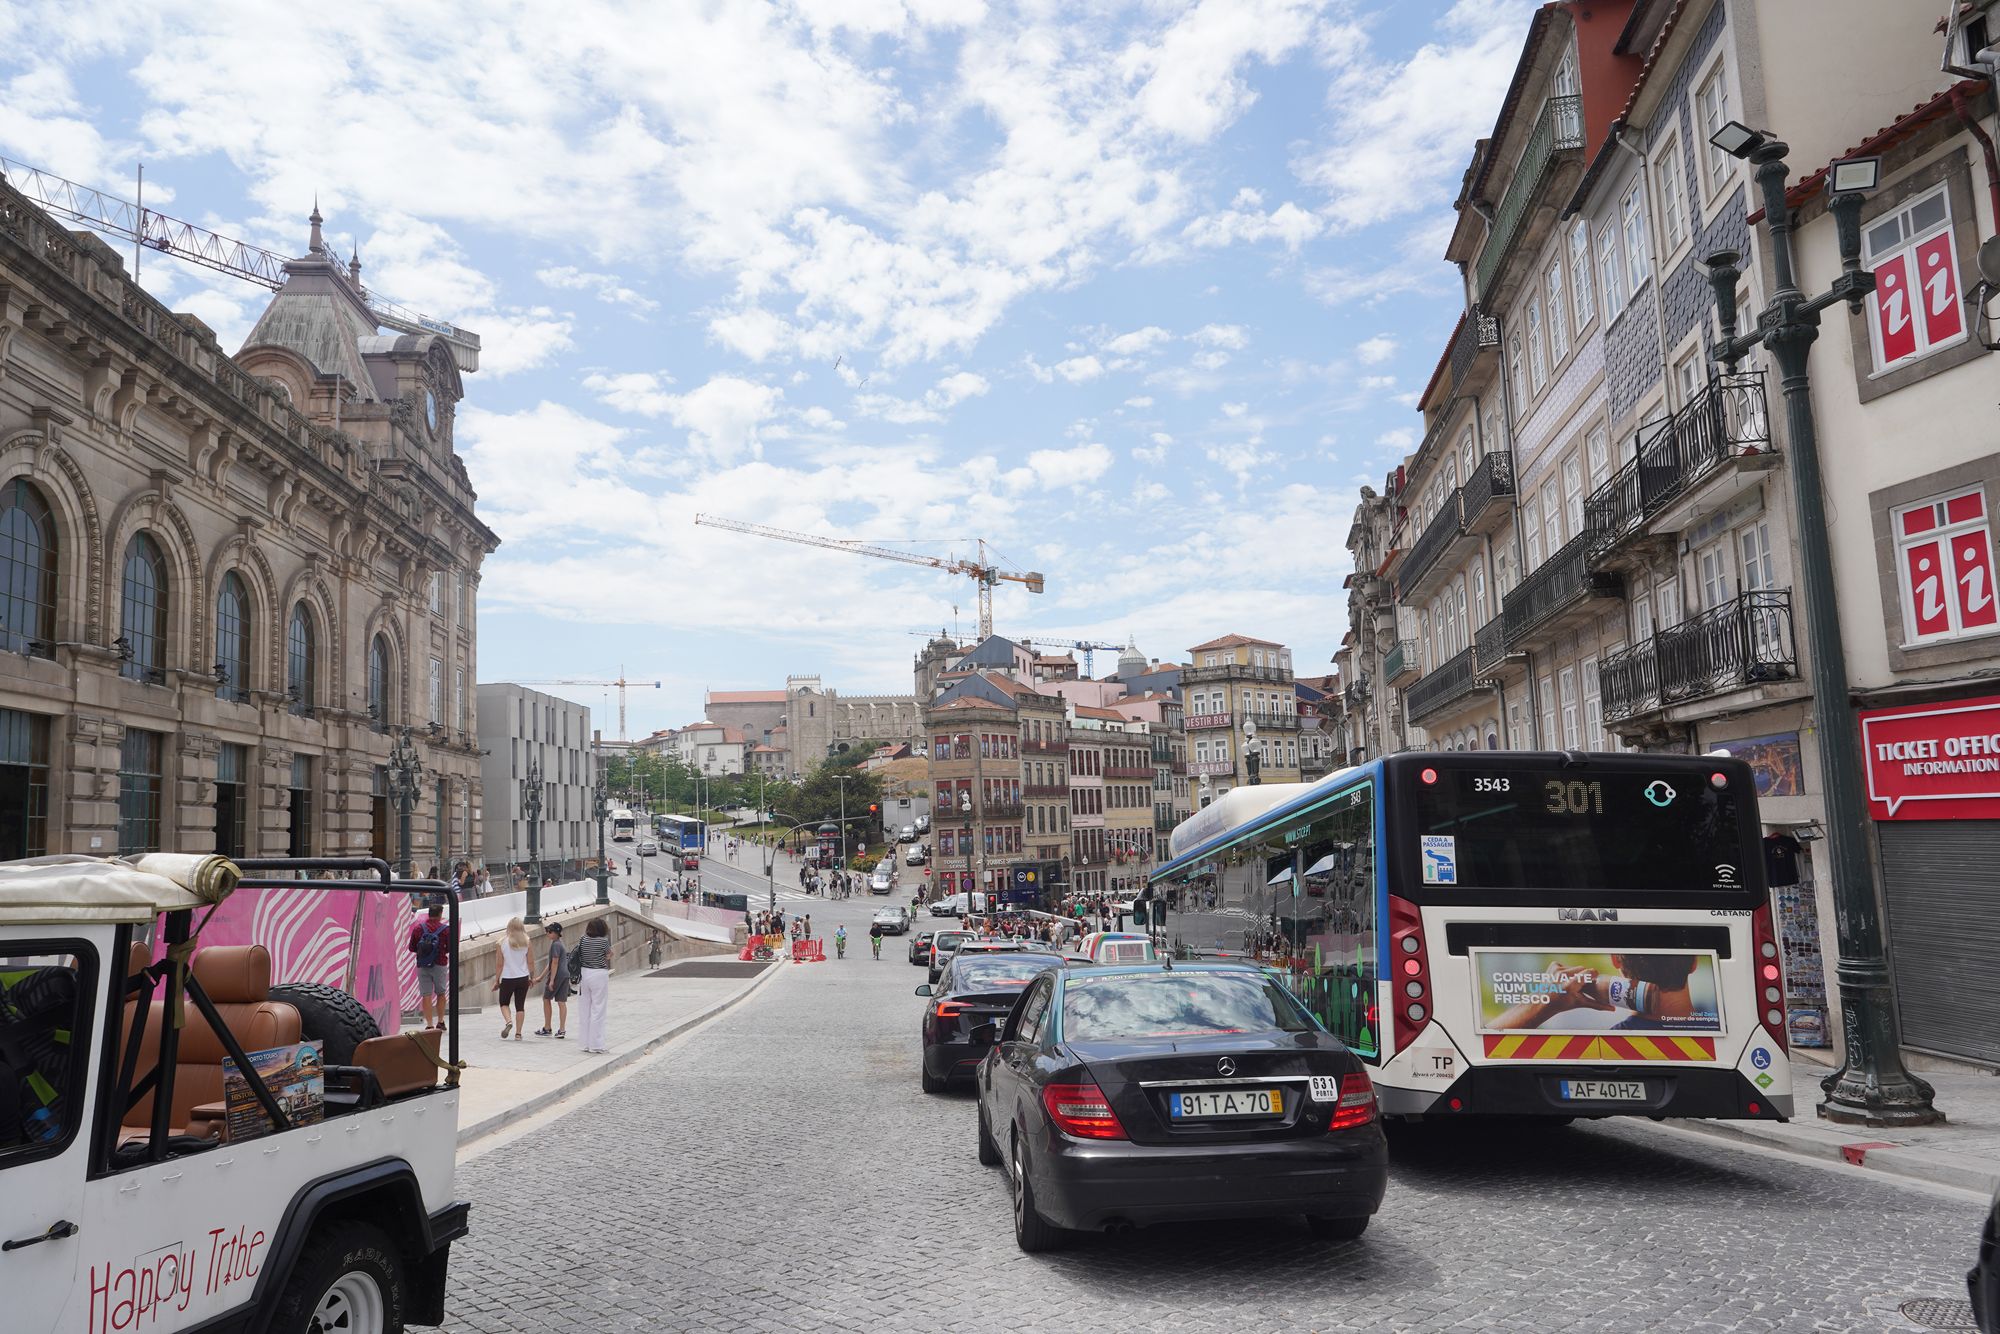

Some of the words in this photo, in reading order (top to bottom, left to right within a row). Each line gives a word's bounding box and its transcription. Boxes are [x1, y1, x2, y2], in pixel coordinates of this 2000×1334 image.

[1185, 716, 1212, 728] VESTIR
[1213, 714, 1230, 725] BEM
[1876, 739, 1939, 762] TICKET
[1944, 733, 2000, 757] OFFIC
[1198, 762, 1229, 774] BARATO
[1903, 758, 2000, 776] INFORMATION
[1474, 778, 1510, 792] 3543
[1545, 780, 1603, 814] 301
[1557, 907, 1619, 922] MAN
[1492, 972, 1593, 984] CONSERVA-TE
[1493, 983, 1527, 994] NUM
[1528, 983, 1567, 994] UCAL
[1494, 993, 1551, 1005] FRESCO
[1432, 1056, 1453, 1070] TP
[1312, 1077, 1334, 1090] 631
[88, 1250, 196, 1334] Happy
